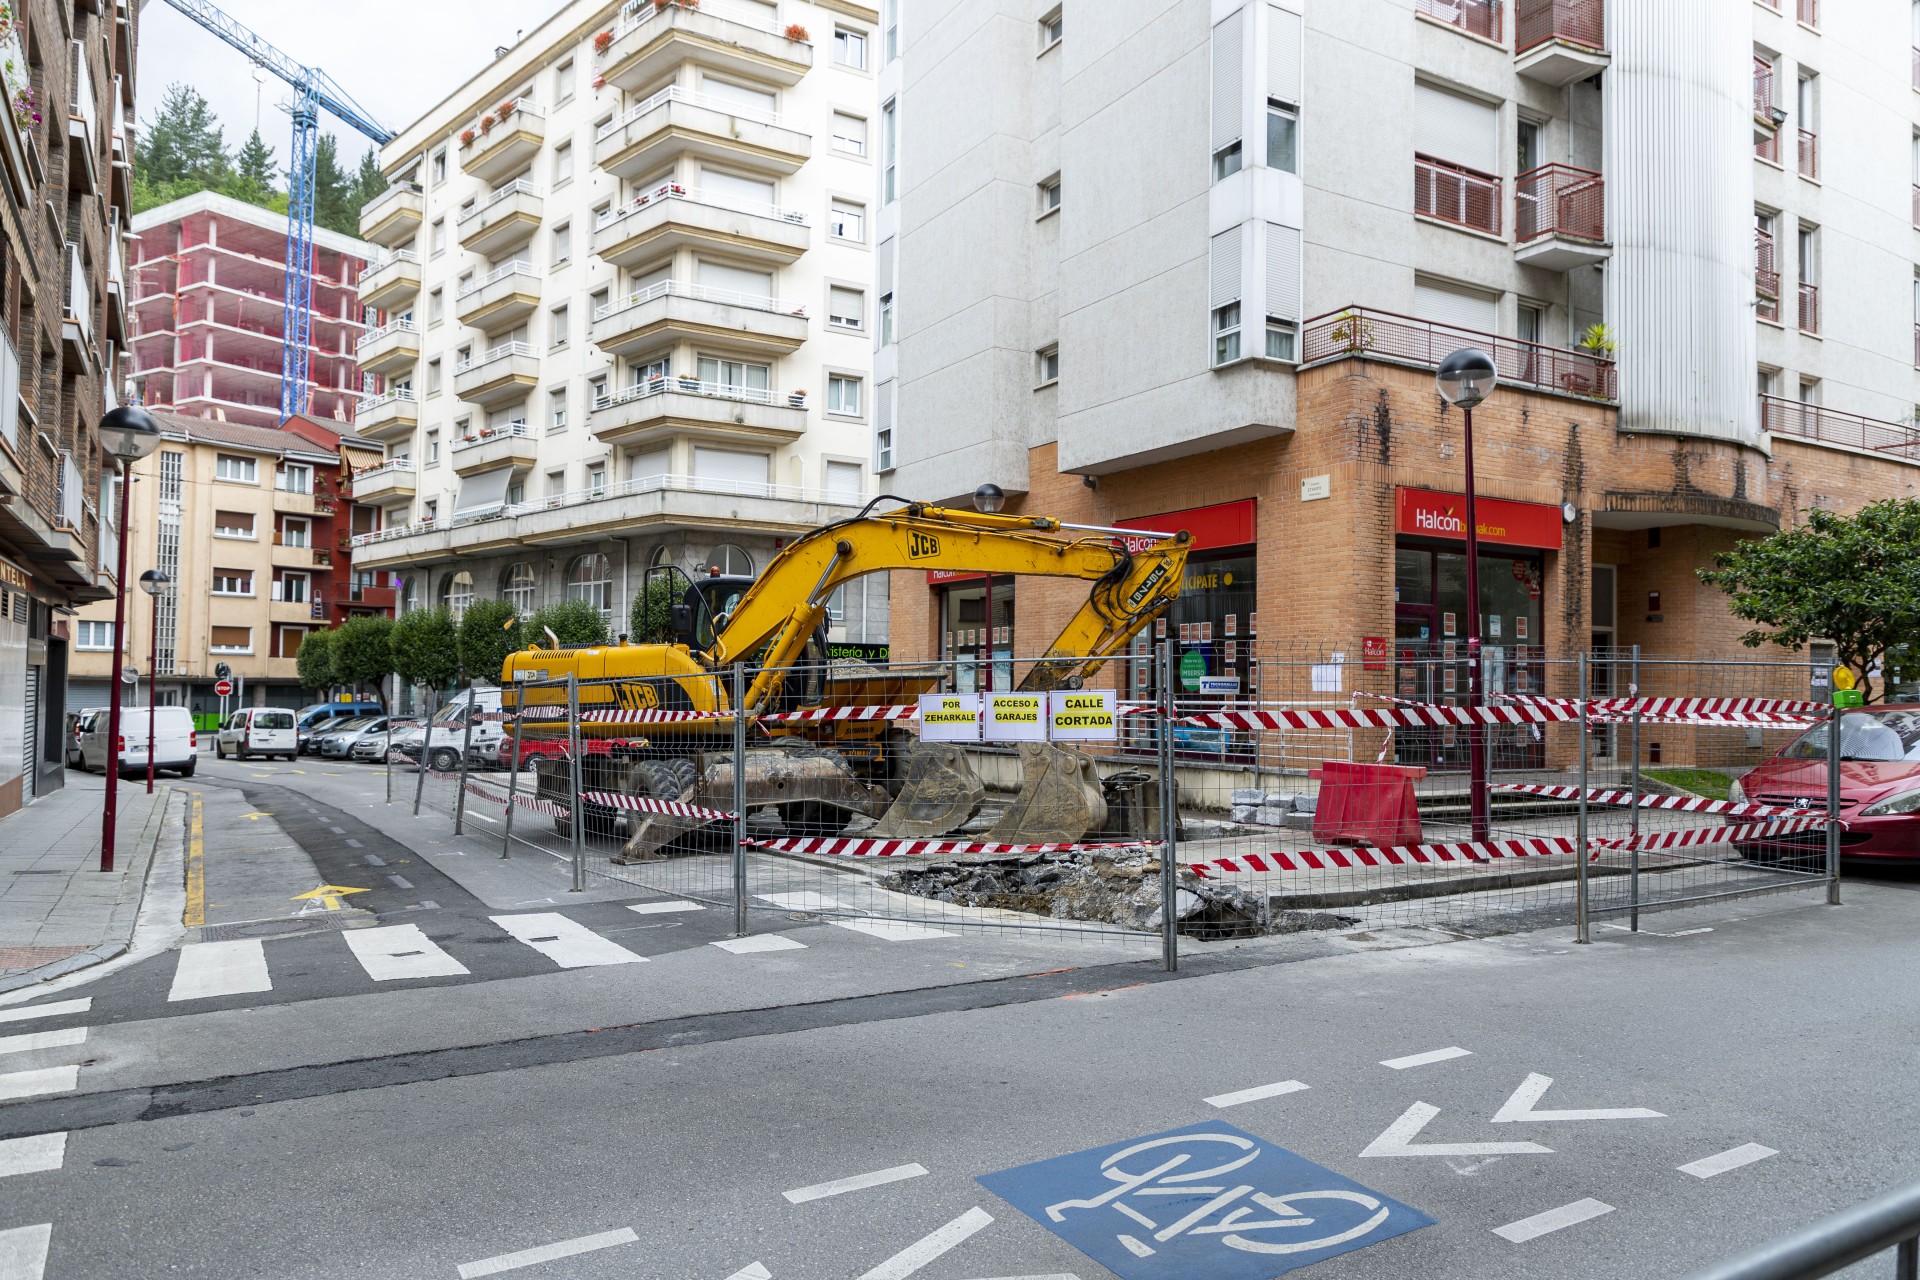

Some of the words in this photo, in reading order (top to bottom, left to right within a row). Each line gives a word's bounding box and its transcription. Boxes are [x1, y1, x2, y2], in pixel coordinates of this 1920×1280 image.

[911, 532, 938, 557] JCB
[1133, 569, 1165, 601] JS175
[620, 683, 657, 710] JCB
[942, 701, 960, 709] POR
[993, 699, 1031, 708] ACCESO
[1033, 700, 1039, 708] A
[1064, 698, 1104, 709] CALLE
[924, 713, 976, 722] ZEHARKALE
[995, 712, 1038, 721] GARAJES
[1055, 715, 1113, 726] CORTADA
